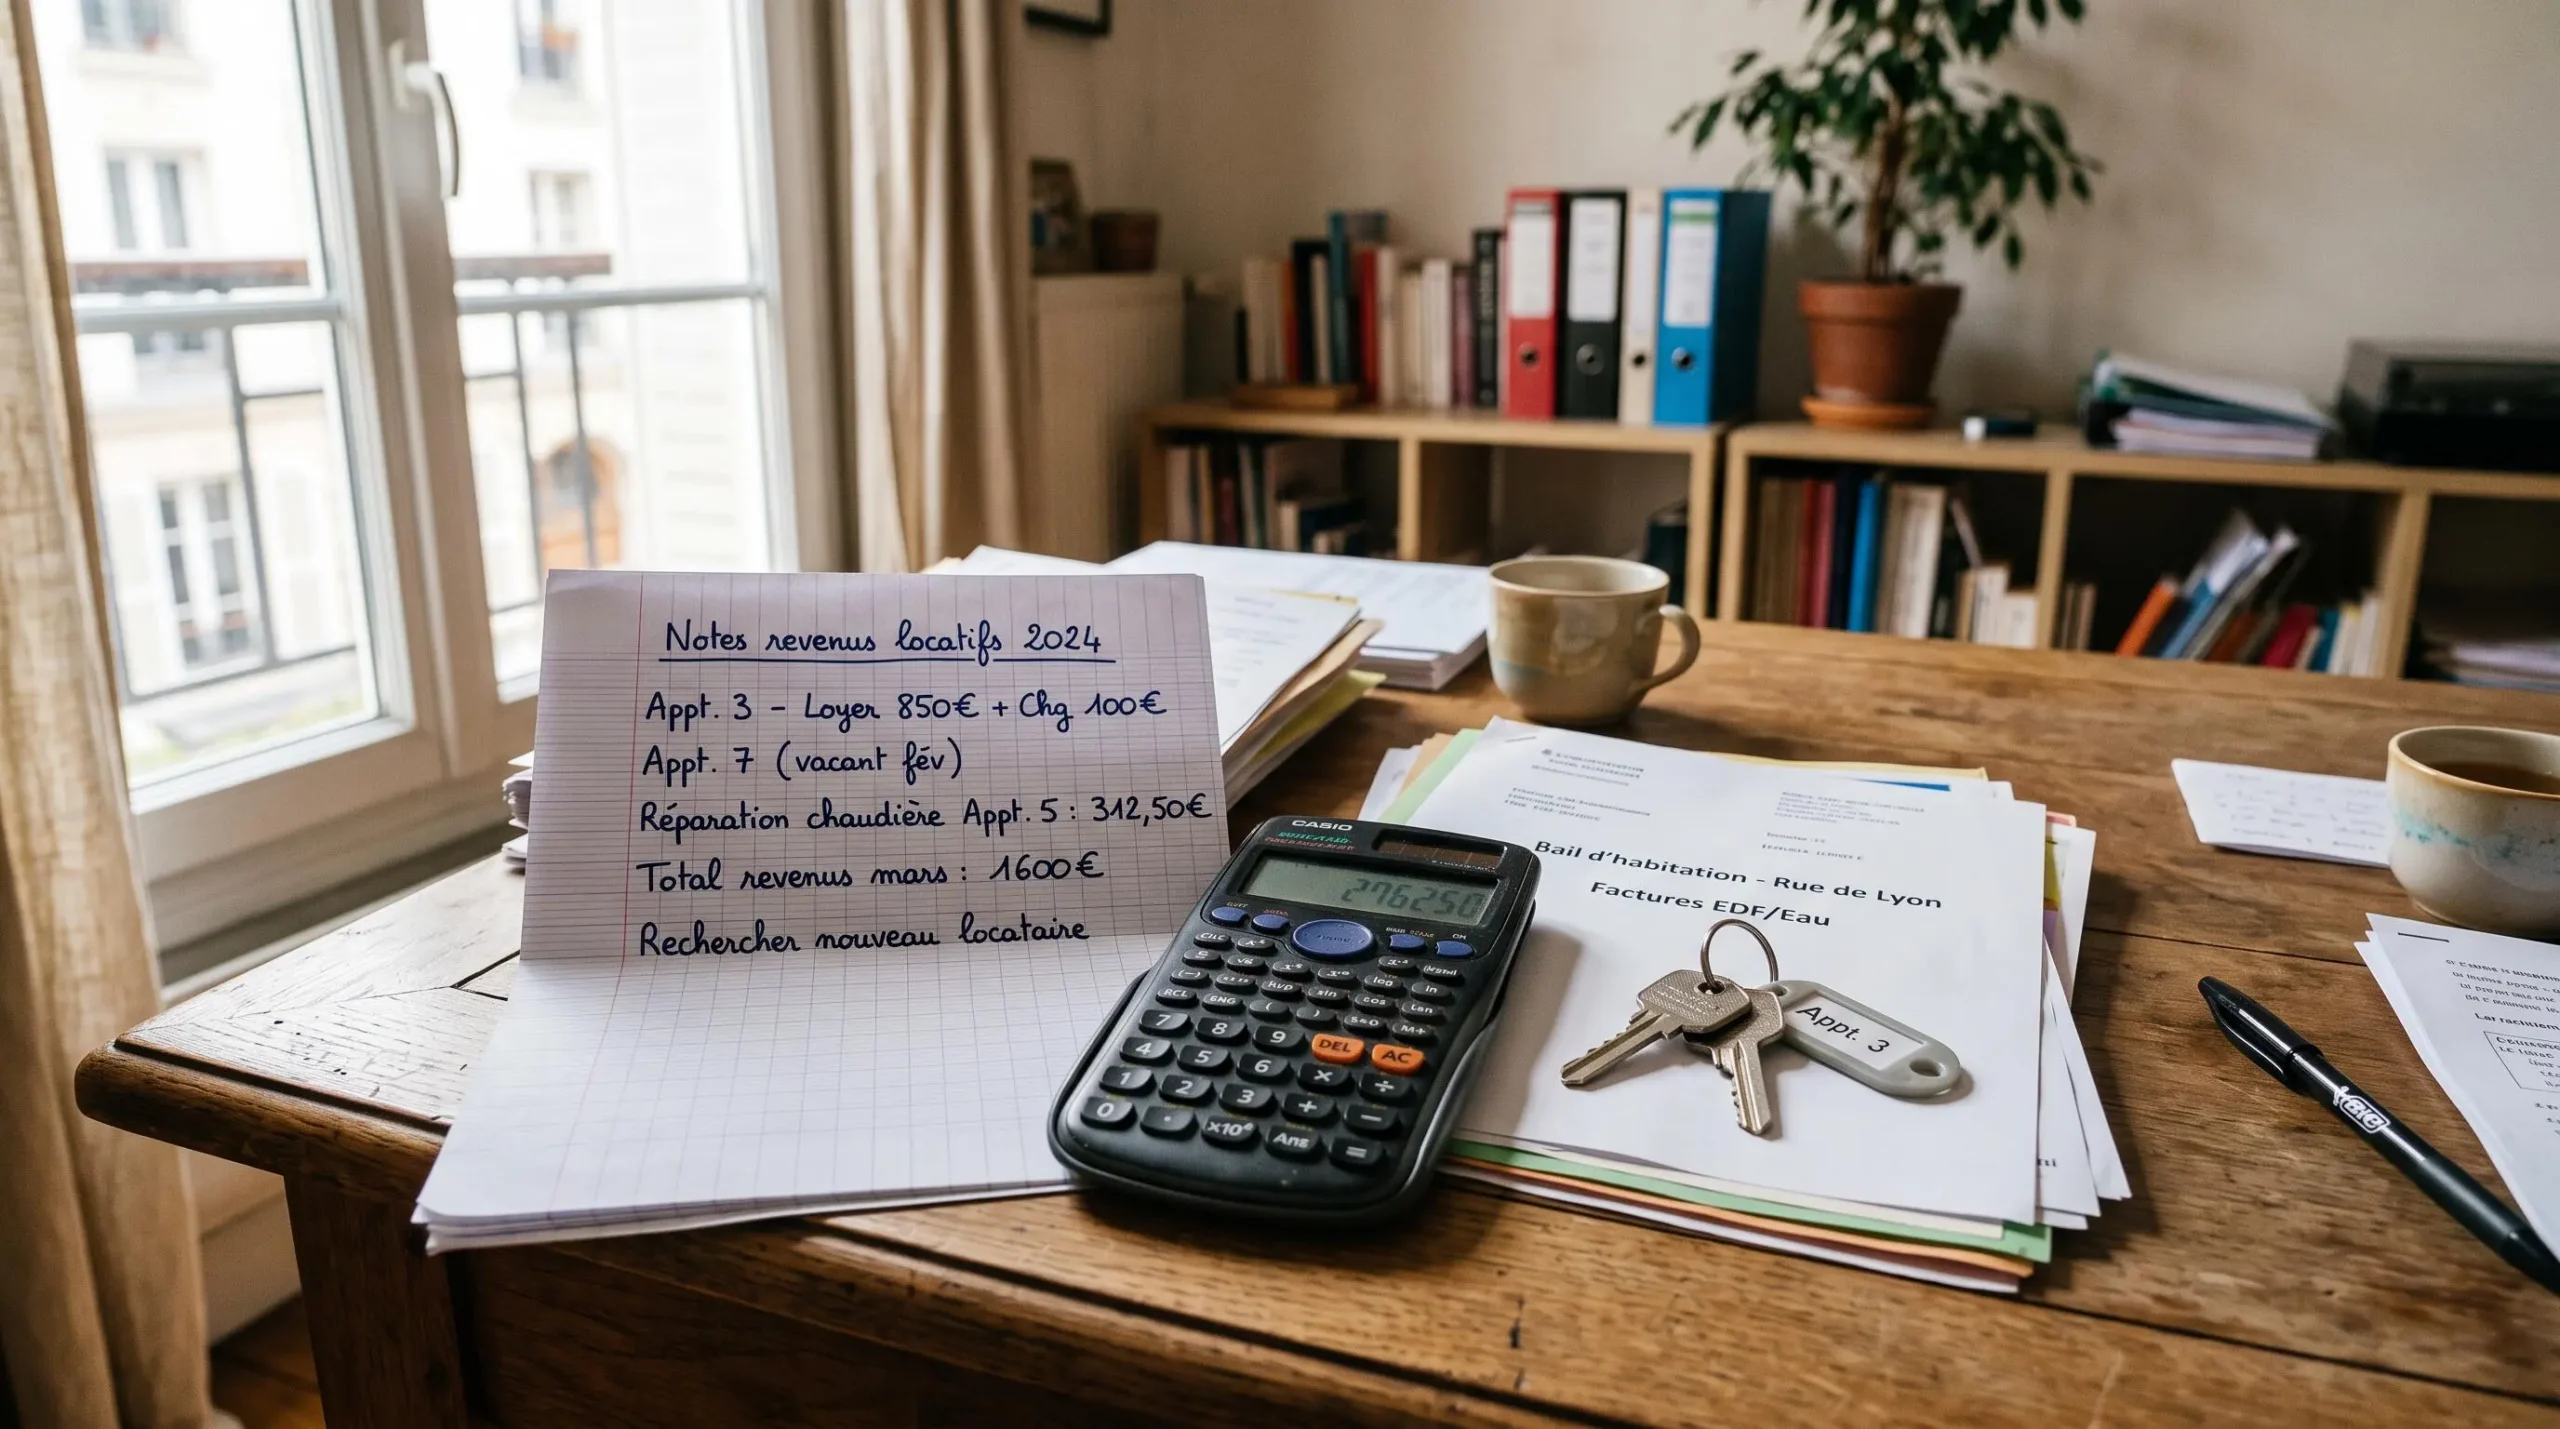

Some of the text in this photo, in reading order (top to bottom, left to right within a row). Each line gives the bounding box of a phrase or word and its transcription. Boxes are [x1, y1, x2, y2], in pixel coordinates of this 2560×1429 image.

[666, 618, 1102, 667] Notes revenus locatifs 2024
[645, 691, 720, 733] Appt.
[733, 692, 752, 721] 3
[804, 692, 881, 734] Loyer
[897, 692, 980, 720] 850€
[991, 700, 1009, 717] +
[1019, 688, 1075, 733] Chg
[1084, 690, 1167, 717] 100€
[642, 737, 962, 788] Appt. 7 (vacant fév)
[640, 800, 790, 846] Réparation
[806, 796, 946, 831] chaudière
[962, 797, 1031, 838] Appt.
[1040, 797, 1059, 824] 5
[1090, 792, 1213, 828] 312,50€
[1291, 819, 1353, 832] CASIO
[635, 857, 723, 893] Total
[739, 868, 853, 891] revenus
[870, 866, 948, 886] mars
[988, 850, 1105, 882] 1600€
[1534, 840, 1583, 858] Bail
[1588, 850, 1747, 883] d’habitation
[1773, 876, 1825, 894] Rue
[1833, 885, 1868, 899] de
[1876, 889, 1942, 909] Lyon
[1590, 881, 1831, 927] Factures EDF/Eau
[639, 910, 1091, 957] Rechercher nouveau locataire
[1163, 988, 1189, 998] RCL
[1155, 1013, 1172, 1027] 7
[1211, 1022, 1228, 1035] 8
[1795, 1005, 1891, 1053] Appt. 3
[1270, 1030, 1287, 1044] 9
[1135, 1042, 1152, 1055] 4
[1318, 1038, 1351, 1053] DEL
[1194, 1050, 1213, 1064] 5
[1381, 1051, 1411, 1064] AC
[1254, 1059, 1272, 1073] 6
[1119, 1071, 1132, 1085] 1
[1175, 1080, 1194, 1094] 2
[1236, 1089, 1255, 1104] 3
[1096, 1102, 1115, 1118] 0
